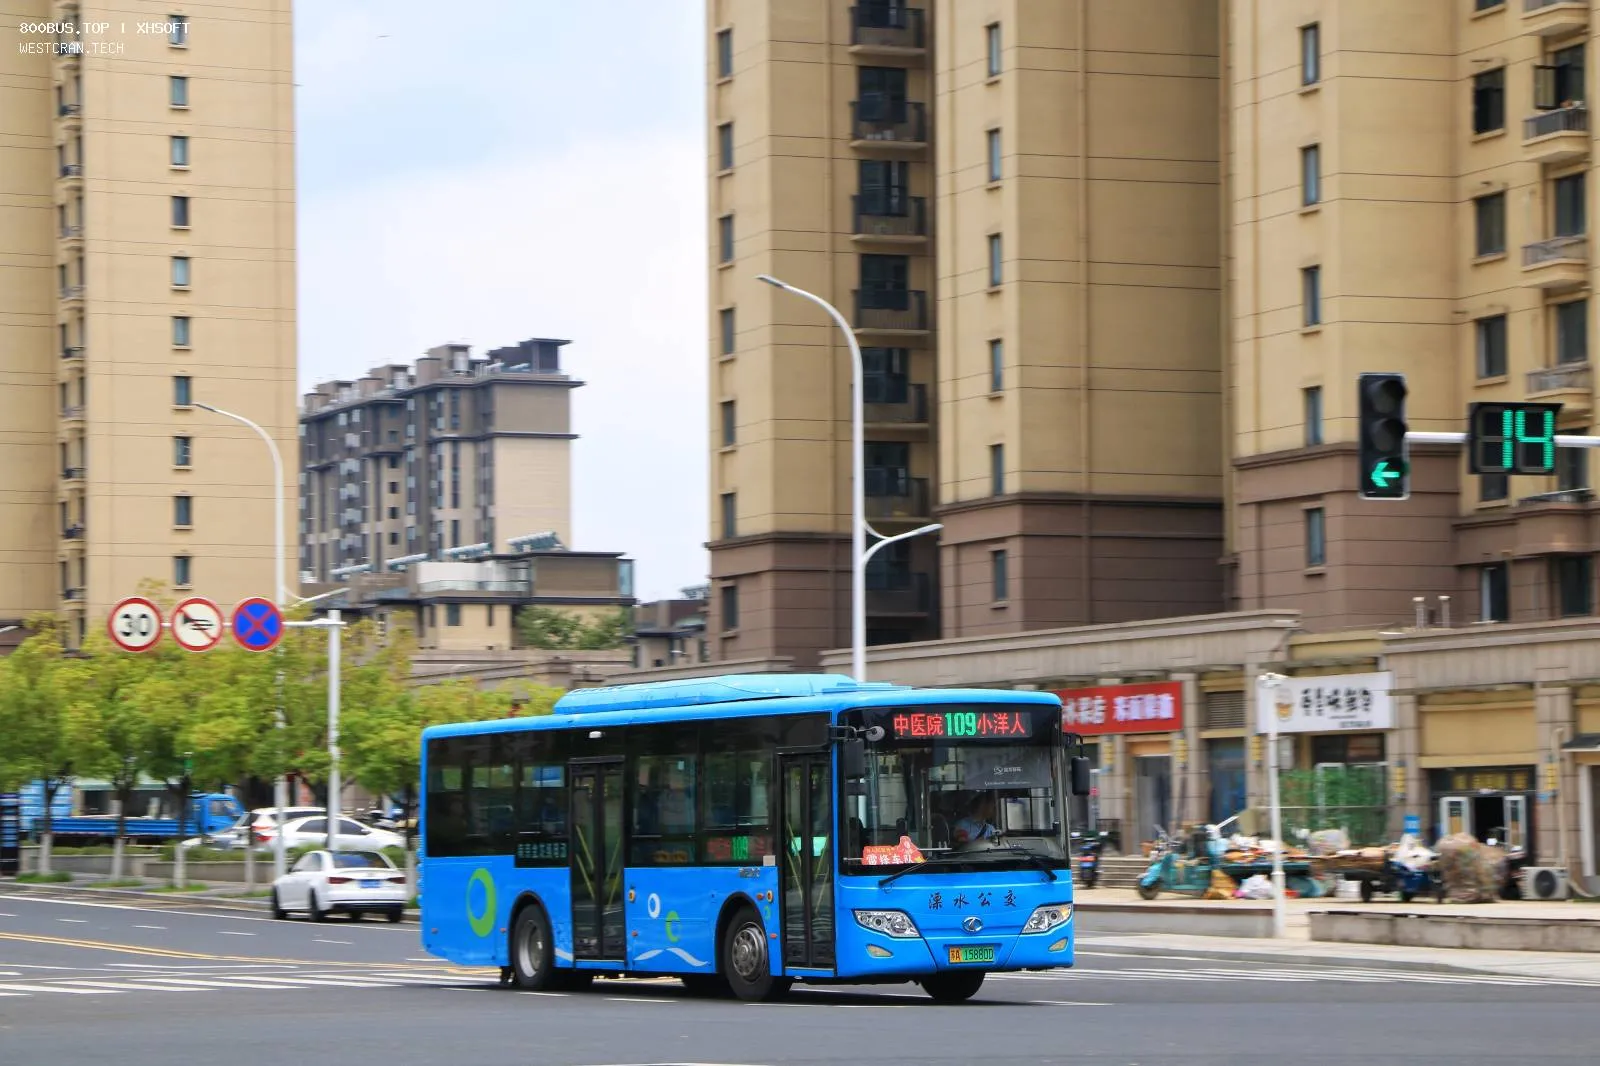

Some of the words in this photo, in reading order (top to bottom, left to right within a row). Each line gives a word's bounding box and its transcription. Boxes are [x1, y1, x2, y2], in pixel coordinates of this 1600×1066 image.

[1503, 409, 1554, 470] 14
[120, 613, 150, 637] 30
[894, 713, 943, 736] 中医院
[945, 712, 977, 736] 109
[977, 712, 1026, 735] 小洋人
[928, 889, 1017, 910] 溧水公交
